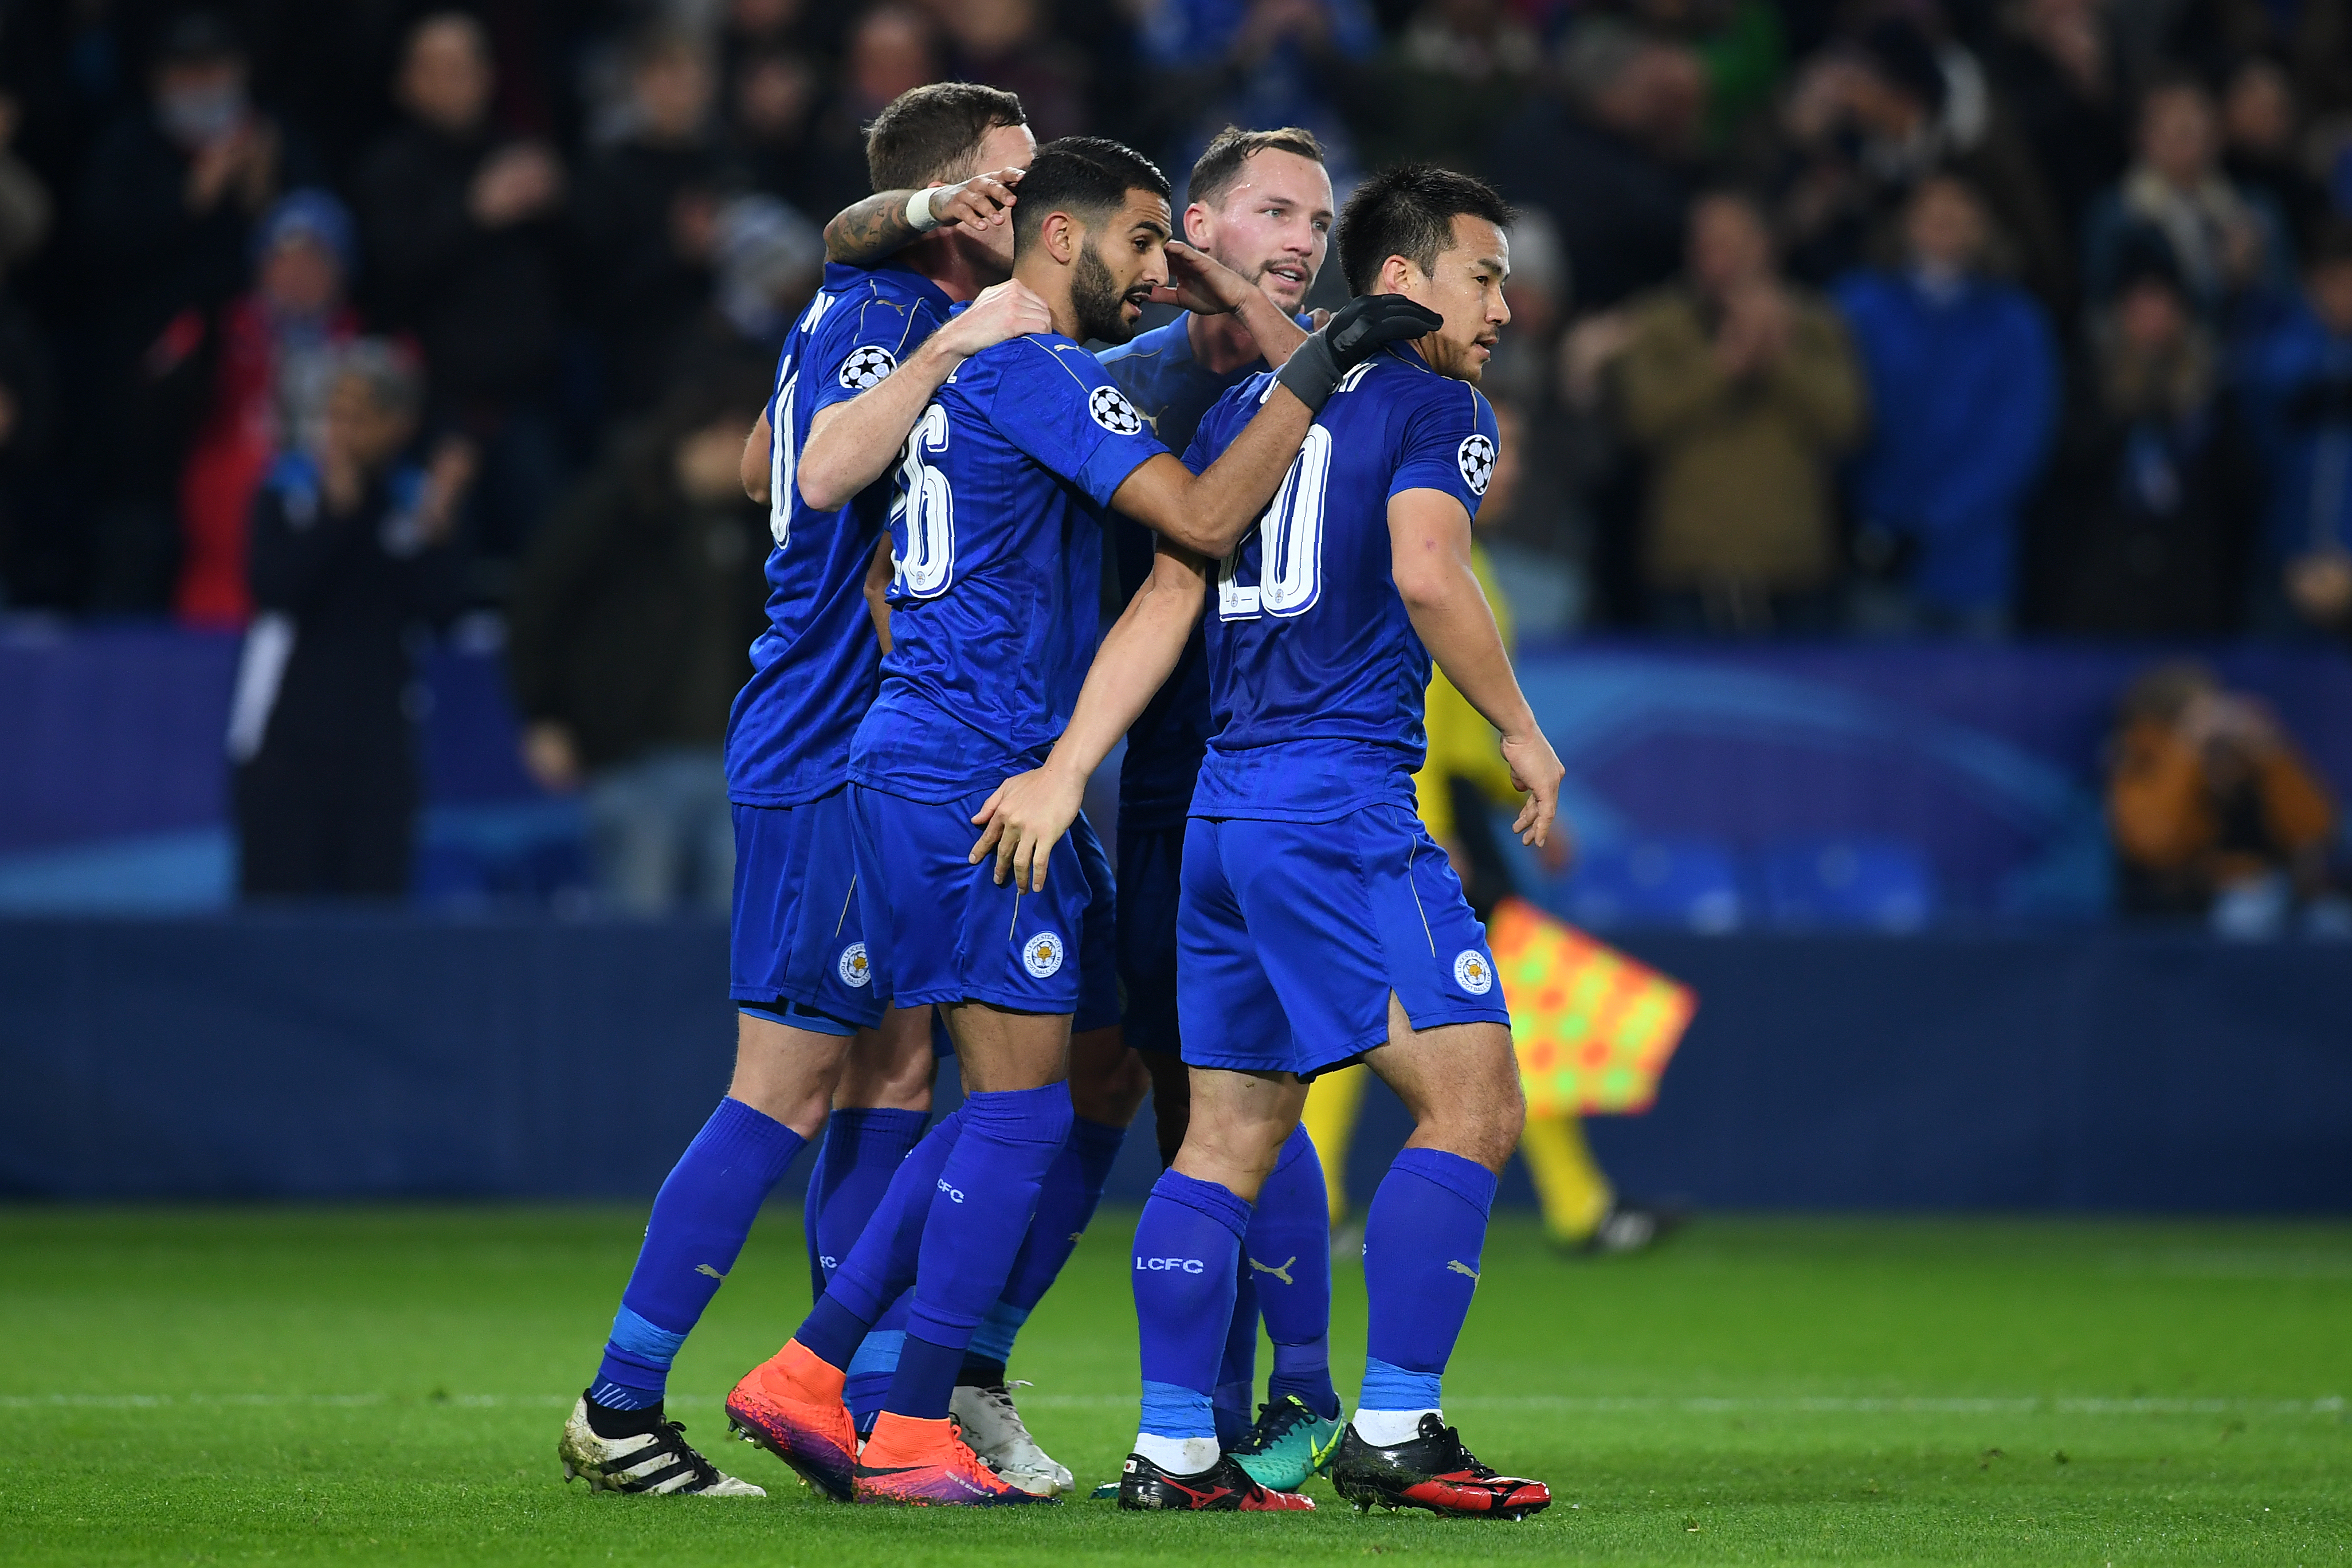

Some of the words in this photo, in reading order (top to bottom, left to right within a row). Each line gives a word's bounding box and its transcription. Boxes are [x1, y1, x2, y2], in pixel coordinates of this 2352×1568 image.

[1026, 935, 1055, 952] LEICESTER
[1457, 952, 1479, 973] LEICESTER
[1136, 1256, 1204, 1274] LCFC
